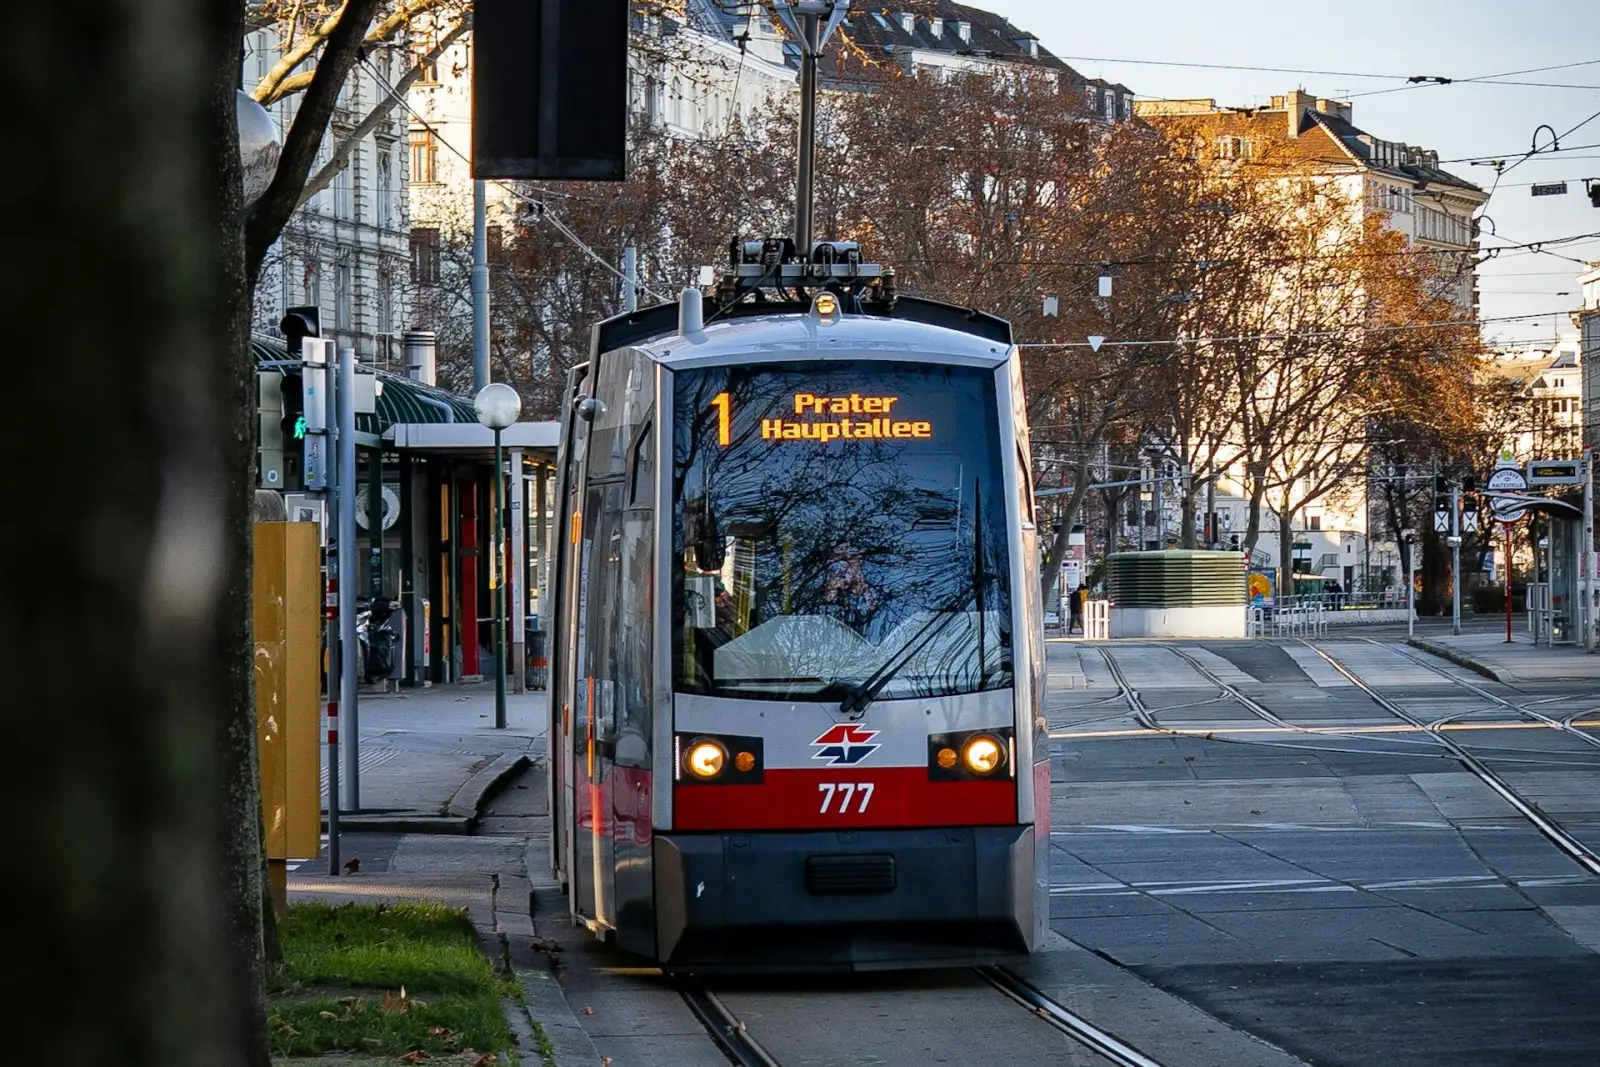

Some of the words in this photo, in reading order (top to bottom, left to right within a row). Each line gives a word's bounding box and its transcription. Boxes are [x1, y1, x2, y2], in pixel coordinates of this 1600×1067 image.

[794, 393, 898, 414] Prater
[711, 392, 731, 446] 1
[761, 418, 931, 442] Hauptallee
[818, 783, 875, 813] 777
